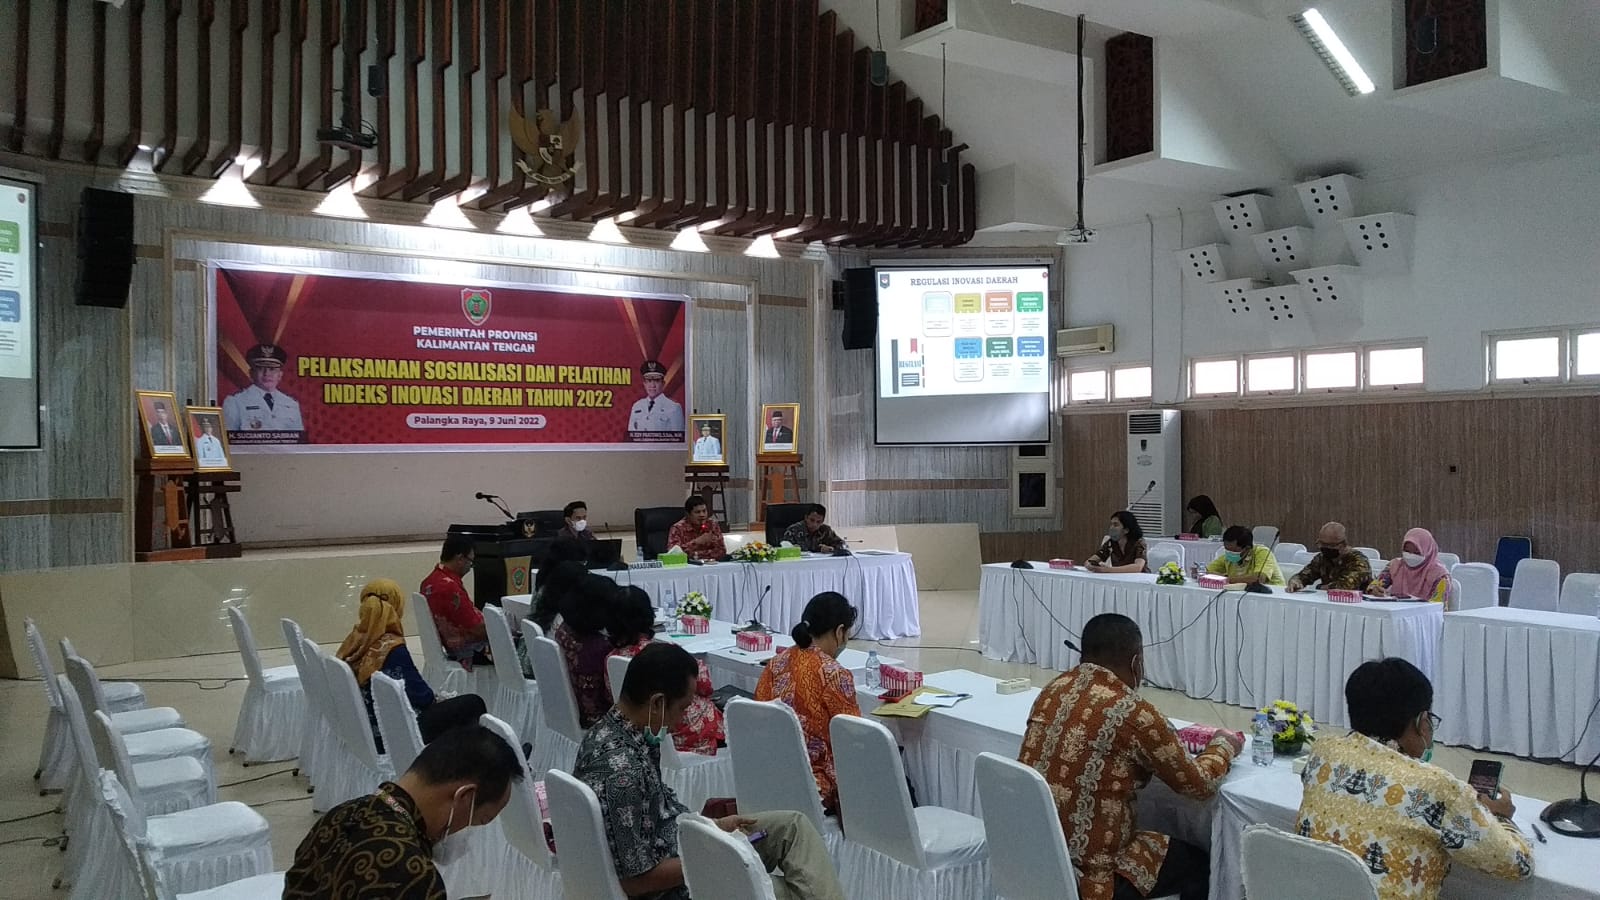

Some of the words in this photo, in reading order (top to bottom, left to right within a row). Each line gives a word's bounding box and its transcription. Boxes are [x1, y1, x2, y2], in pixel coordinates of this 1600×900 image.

[910, 277, 950, 286] REGULASI
[951, 277, 984, 285] INOVASI
[986, 276, 1019, 285] DAERAH
[413, 326, 485, 339] PEMERINTAH
[488, 329, 538, 341] PROVINSI
[416, 339, 490, 351] KALIMANTAN
[492, 342, 535, 353] TENGAH
[298, 356, 421, 379] PELAKSANAAN
[424, 360, 522, 382] SOSIALISASI
[525, 364, 555, 383] DAN
[558, 365, 631, 385] PELATIHAN
[324, 383, 388, 404] INDEKS
[391, 385, 459, 405] INOVASI
[462, 387, 522, 406] DAERAH
[526, 388, 574, 407] TAHUN
[576, 389, 613, 407] 2022
[414, 416, 459, 426] Palangka
[462, 417, 487, 426] Raya,
[490, 417, 495, 425] 9
[497, 416, 517, 425] Juni
[519, 417, 540, 425] 2022
